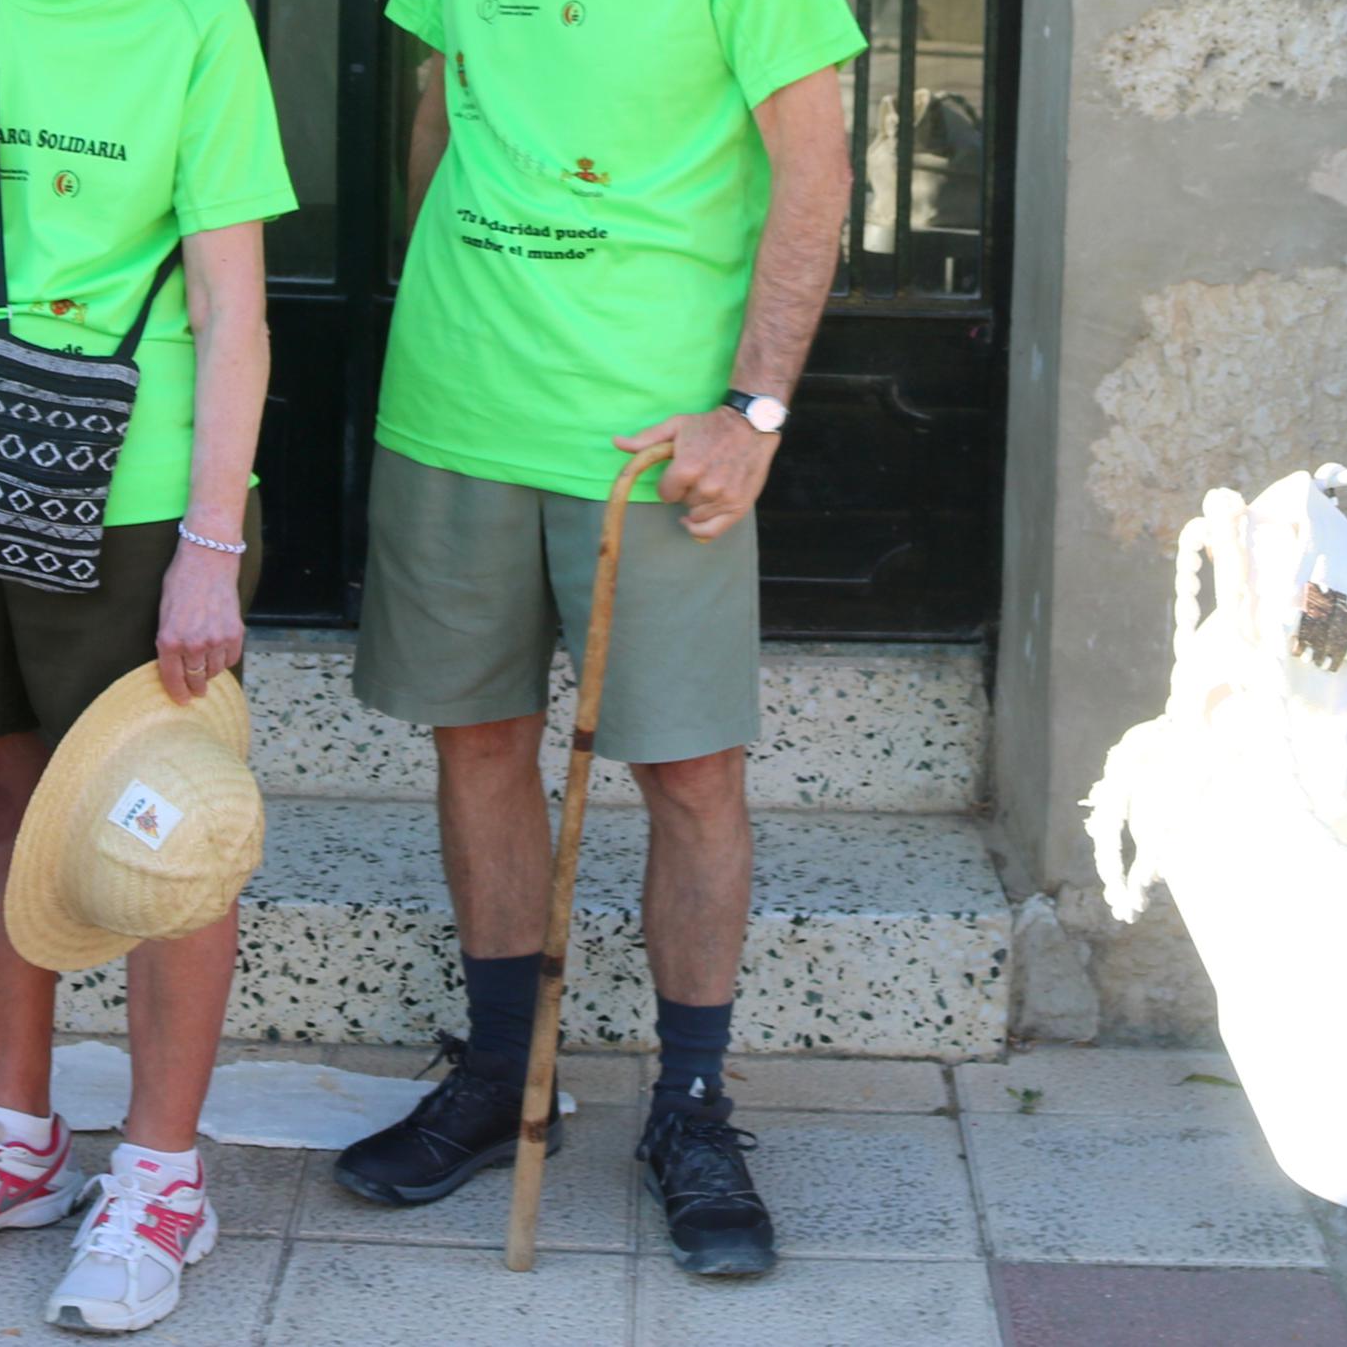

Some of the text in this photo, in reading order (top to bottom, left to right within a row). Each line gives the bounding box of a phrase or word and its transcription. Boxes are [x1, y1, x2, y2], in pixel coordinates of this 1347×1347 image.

[36, 128, 128, 162] SOLIDARIA
[555, 227, 609, 241] puede
[509, 245, 523, 257] el
